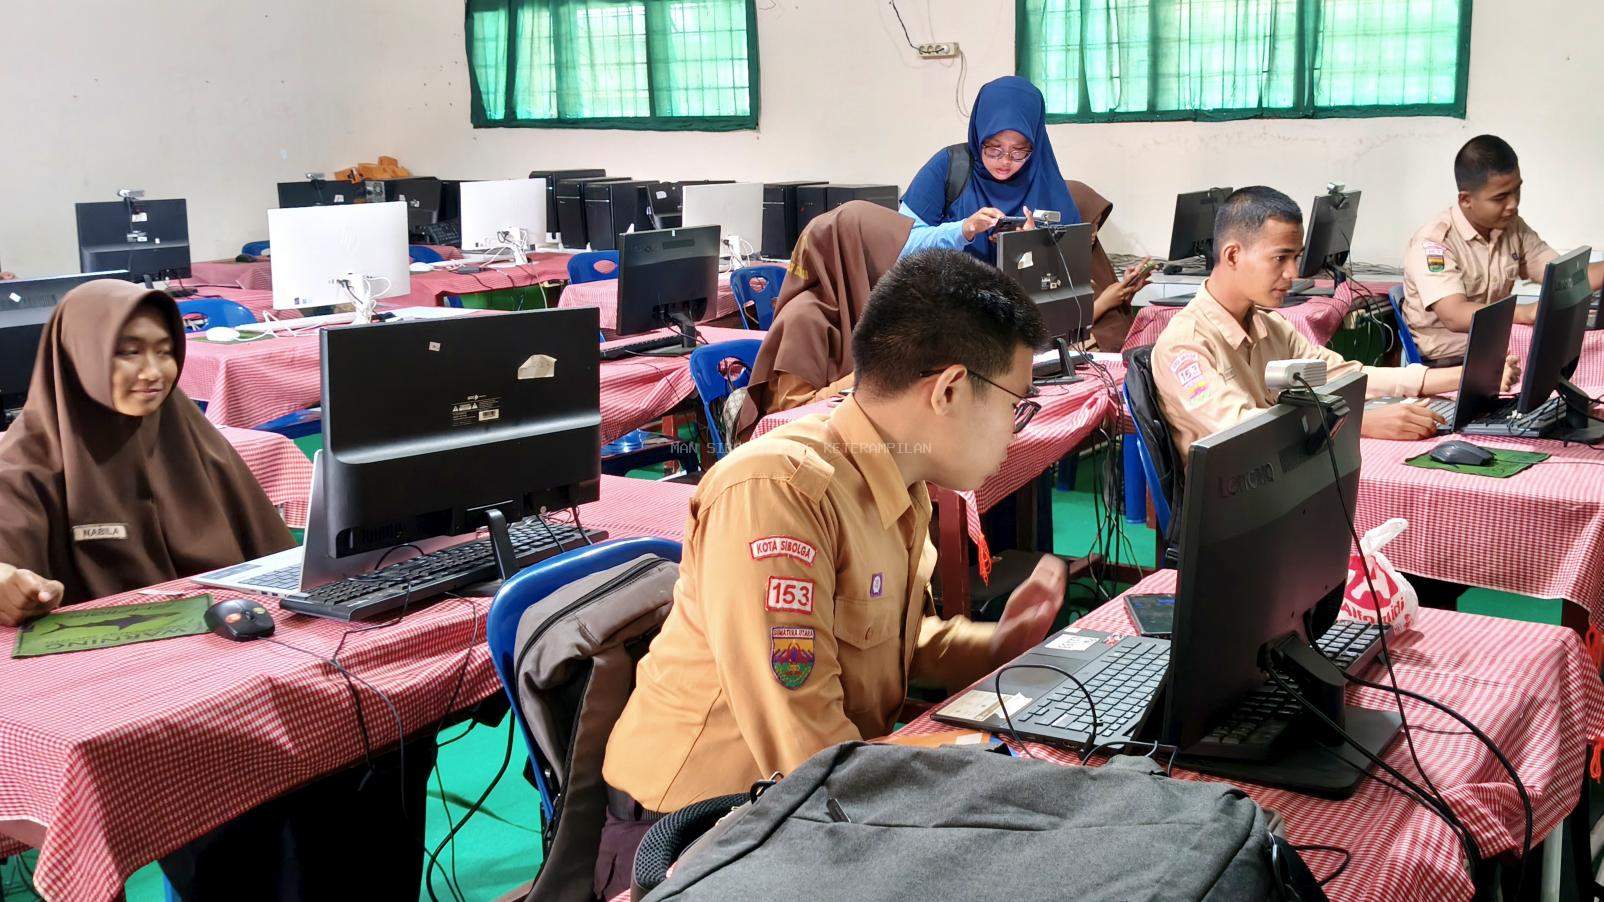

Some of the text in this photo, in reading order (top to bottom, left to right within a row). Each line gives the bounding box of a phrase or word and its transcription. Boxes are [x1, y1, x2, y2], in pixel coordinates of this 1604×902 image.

[757, 540, 811, 558] KOTA SIBOLGA
[773, 582, 809, 606] 153
